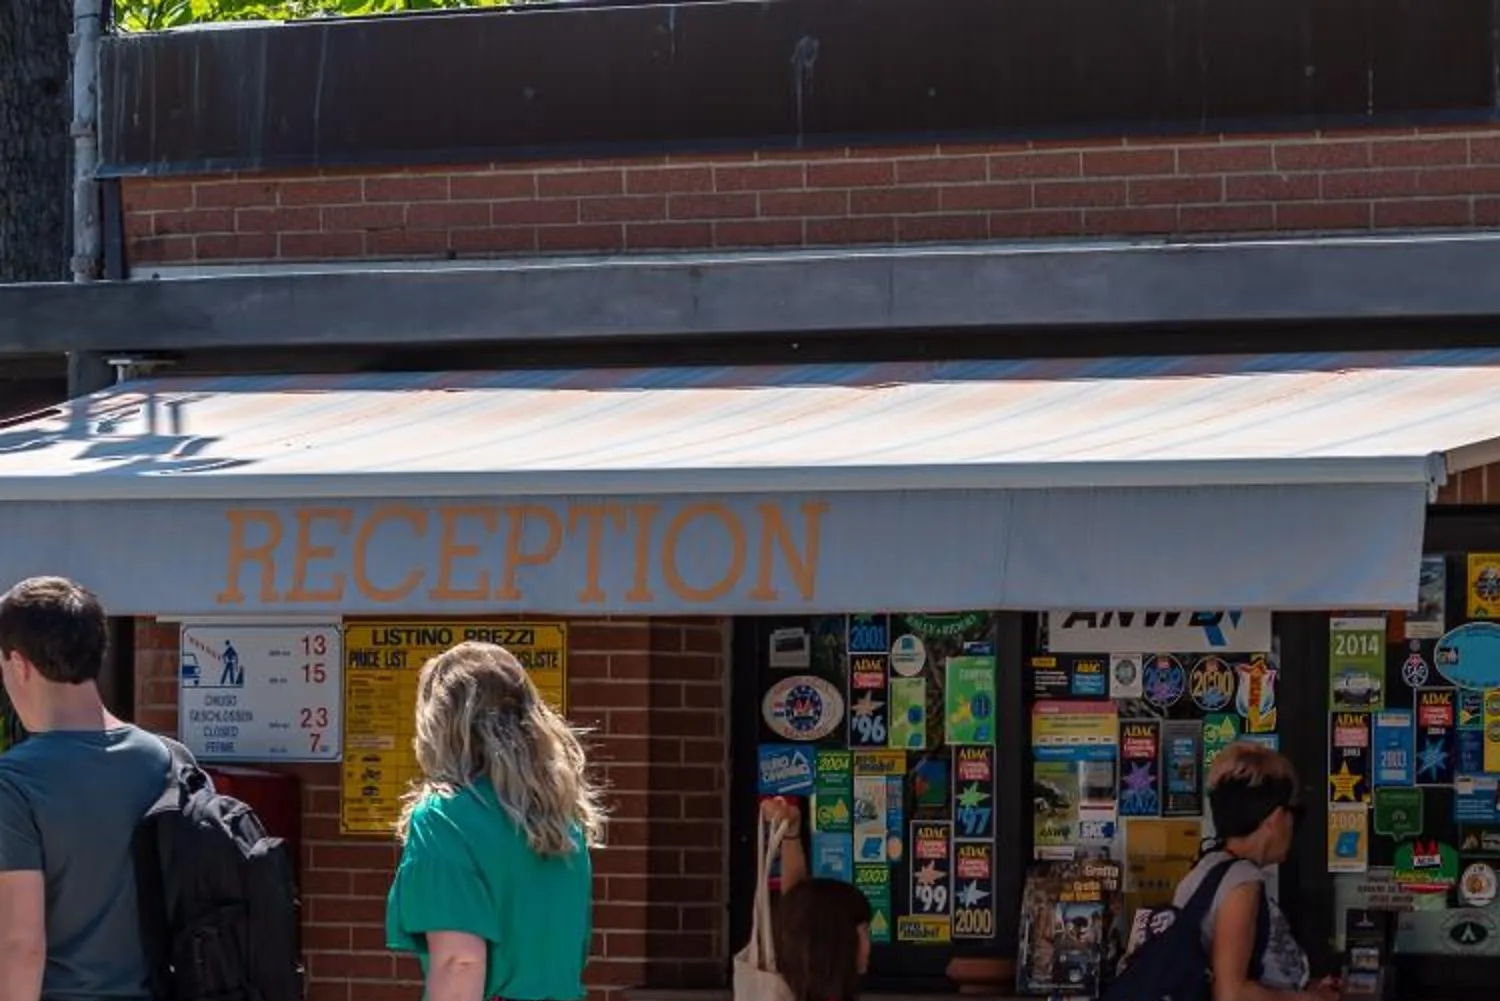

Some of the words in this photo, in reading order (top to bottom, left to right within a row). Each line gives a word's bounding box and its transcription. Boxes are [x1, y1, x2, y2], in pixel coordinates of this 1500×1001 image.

[216, 502, 831, 603] RECEPTION
[301, 635, 326, 656] 13
[372, 628, 452, 646] LISTINO
[464, 628, 534, 646] PREZZI
[851, 625, 886, 649] 2001
[1335, 634, 1379, 655] 2014
[384, 652, 407, 668] LIST
[301, 663, 326, 683] 15
[301, 707, 328, 728] 23
[1124, 725, 1153, 736] ADAC
[916, 885, 947, 912] '99
[956, 910, 991, 932] 2000
